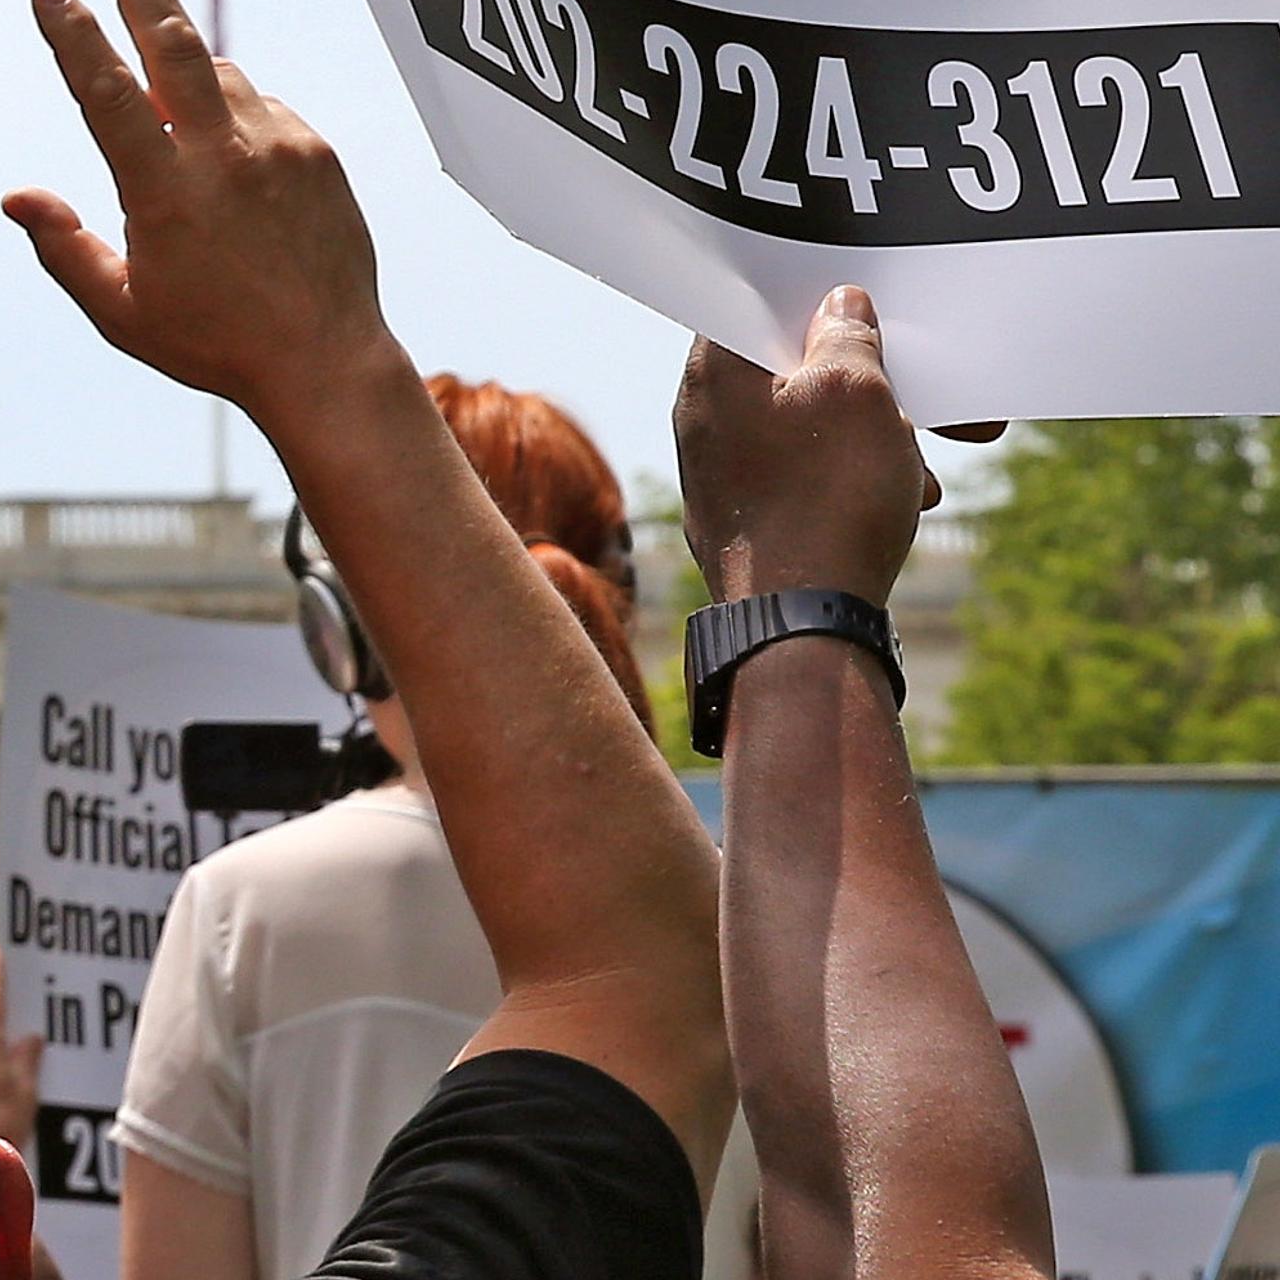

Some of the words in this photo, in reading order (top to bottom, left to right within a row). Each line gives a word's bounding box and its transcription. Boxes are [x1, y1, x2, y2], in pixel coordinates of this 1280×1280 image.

[42, 694, 113, 771] Call
[45, 787, 197, 872] Official
[44, 976, 85, 1048] in
